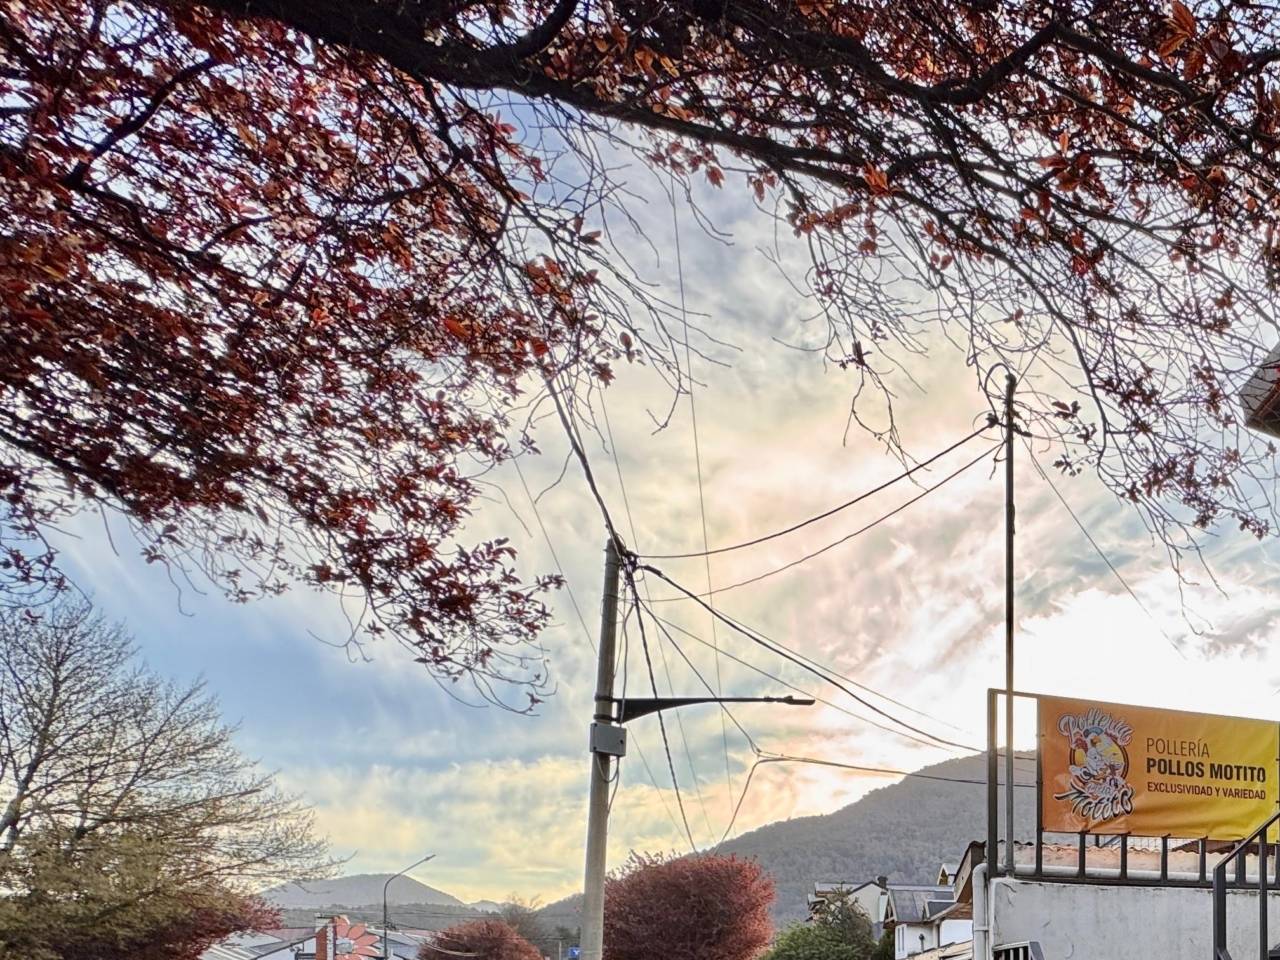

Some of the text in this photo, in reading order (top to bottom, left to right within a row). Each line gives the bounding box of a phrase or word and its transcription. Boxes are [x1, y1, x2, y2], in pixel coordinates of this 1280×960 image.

[1146, 737, 1210, 759] POLLERÍA
[1146, 758, 1267, 783] POLLOS MOTITO
[1147, 782, 1267, 801] EXCLUSIVIDAD Y VARIEDAD
